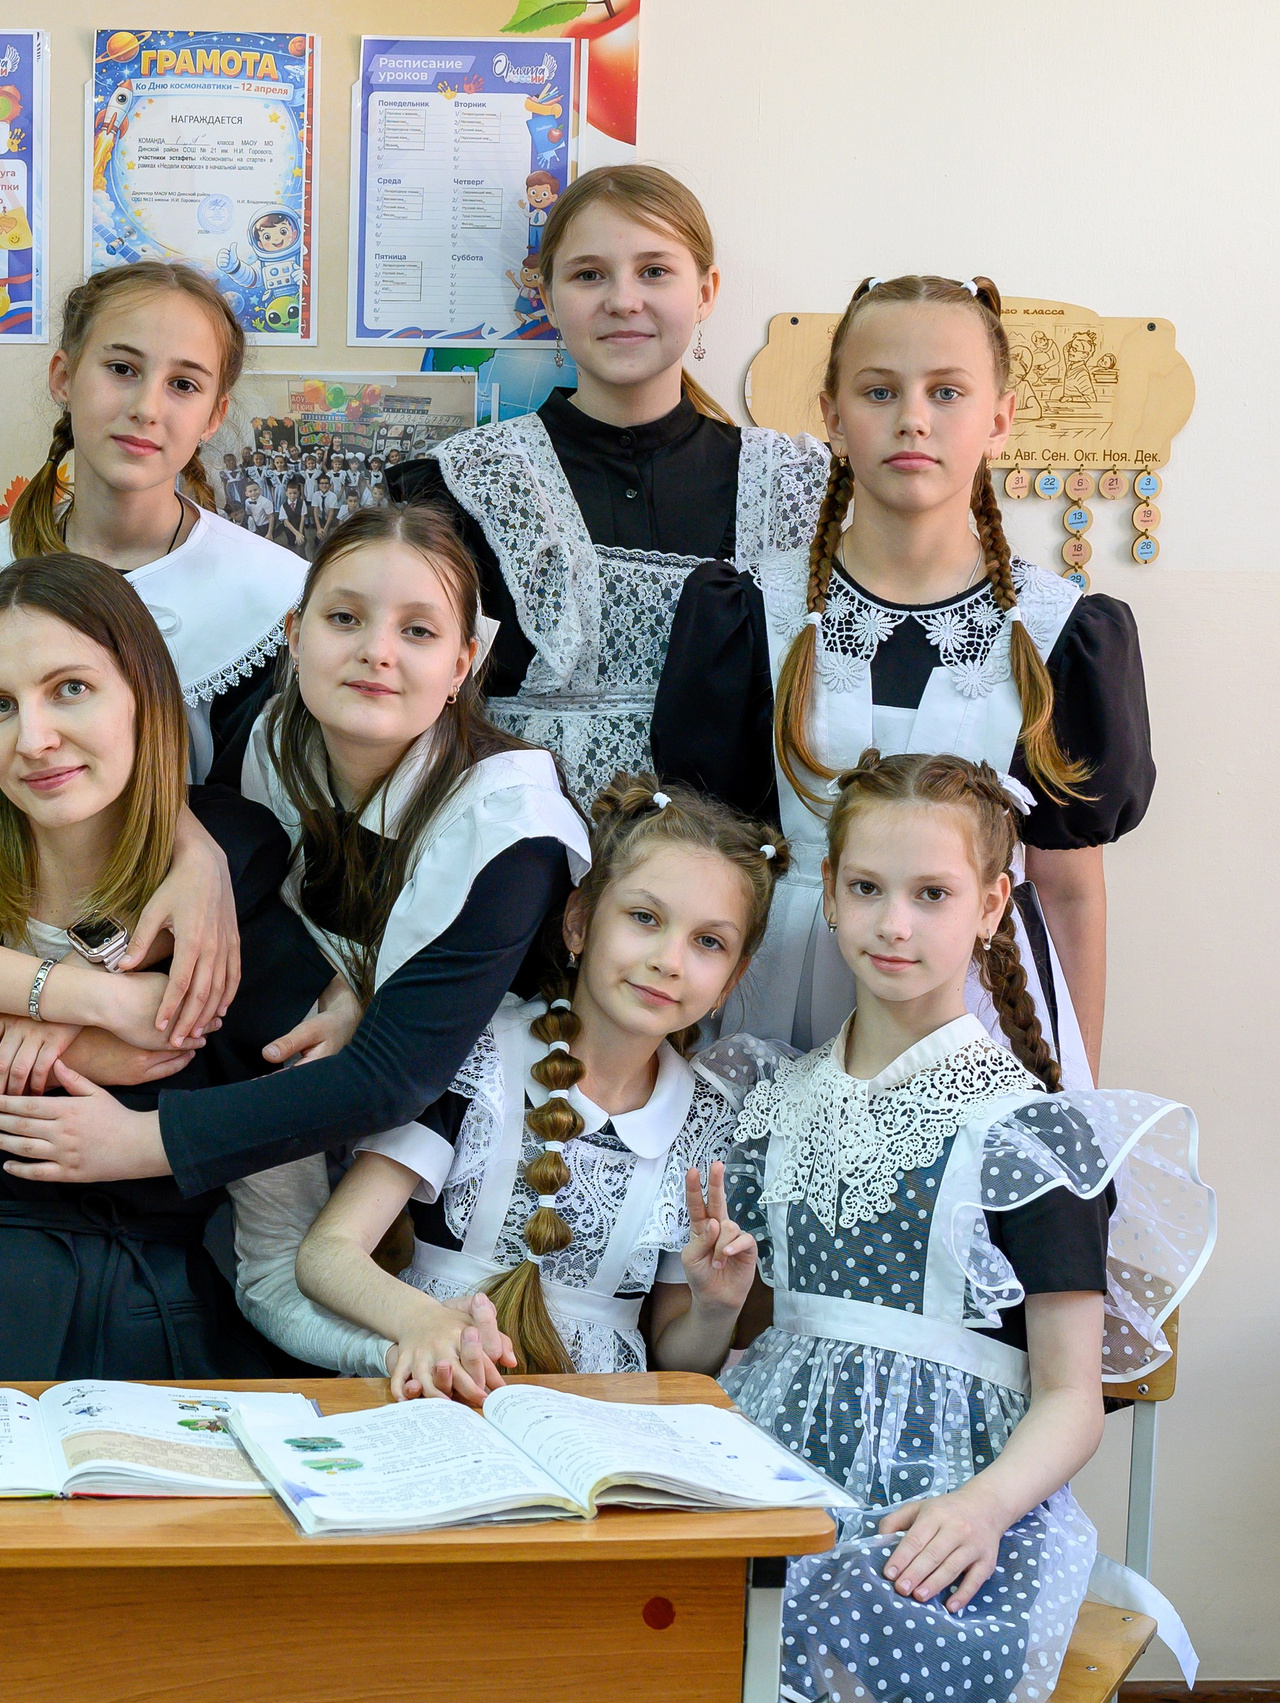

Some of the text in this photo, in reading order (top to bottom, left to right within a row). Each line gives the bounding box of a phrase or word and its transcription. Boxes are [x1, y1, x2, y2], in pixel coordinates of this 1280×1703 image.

[140, 49, 278, 80] ГРАМОТА
[379, 58, 462, 69] Расписание
[494, 53, 545, 78] Орлята
[378, 71, 427, 82] уроков
[136, 82, 288, 95] Ко Дню космонавтики 12 апреля
[171, 115, 242, 125] НАГРАЖДАЕТСЯ
[452, 254, 483, 262] Суббота
[1014, 449, 1160, 464] Авг. Сен. Окт. Ноя. Дек.
[1015, 477, 1024, 485] 31
[1073, 512, 1082, 520] 13
